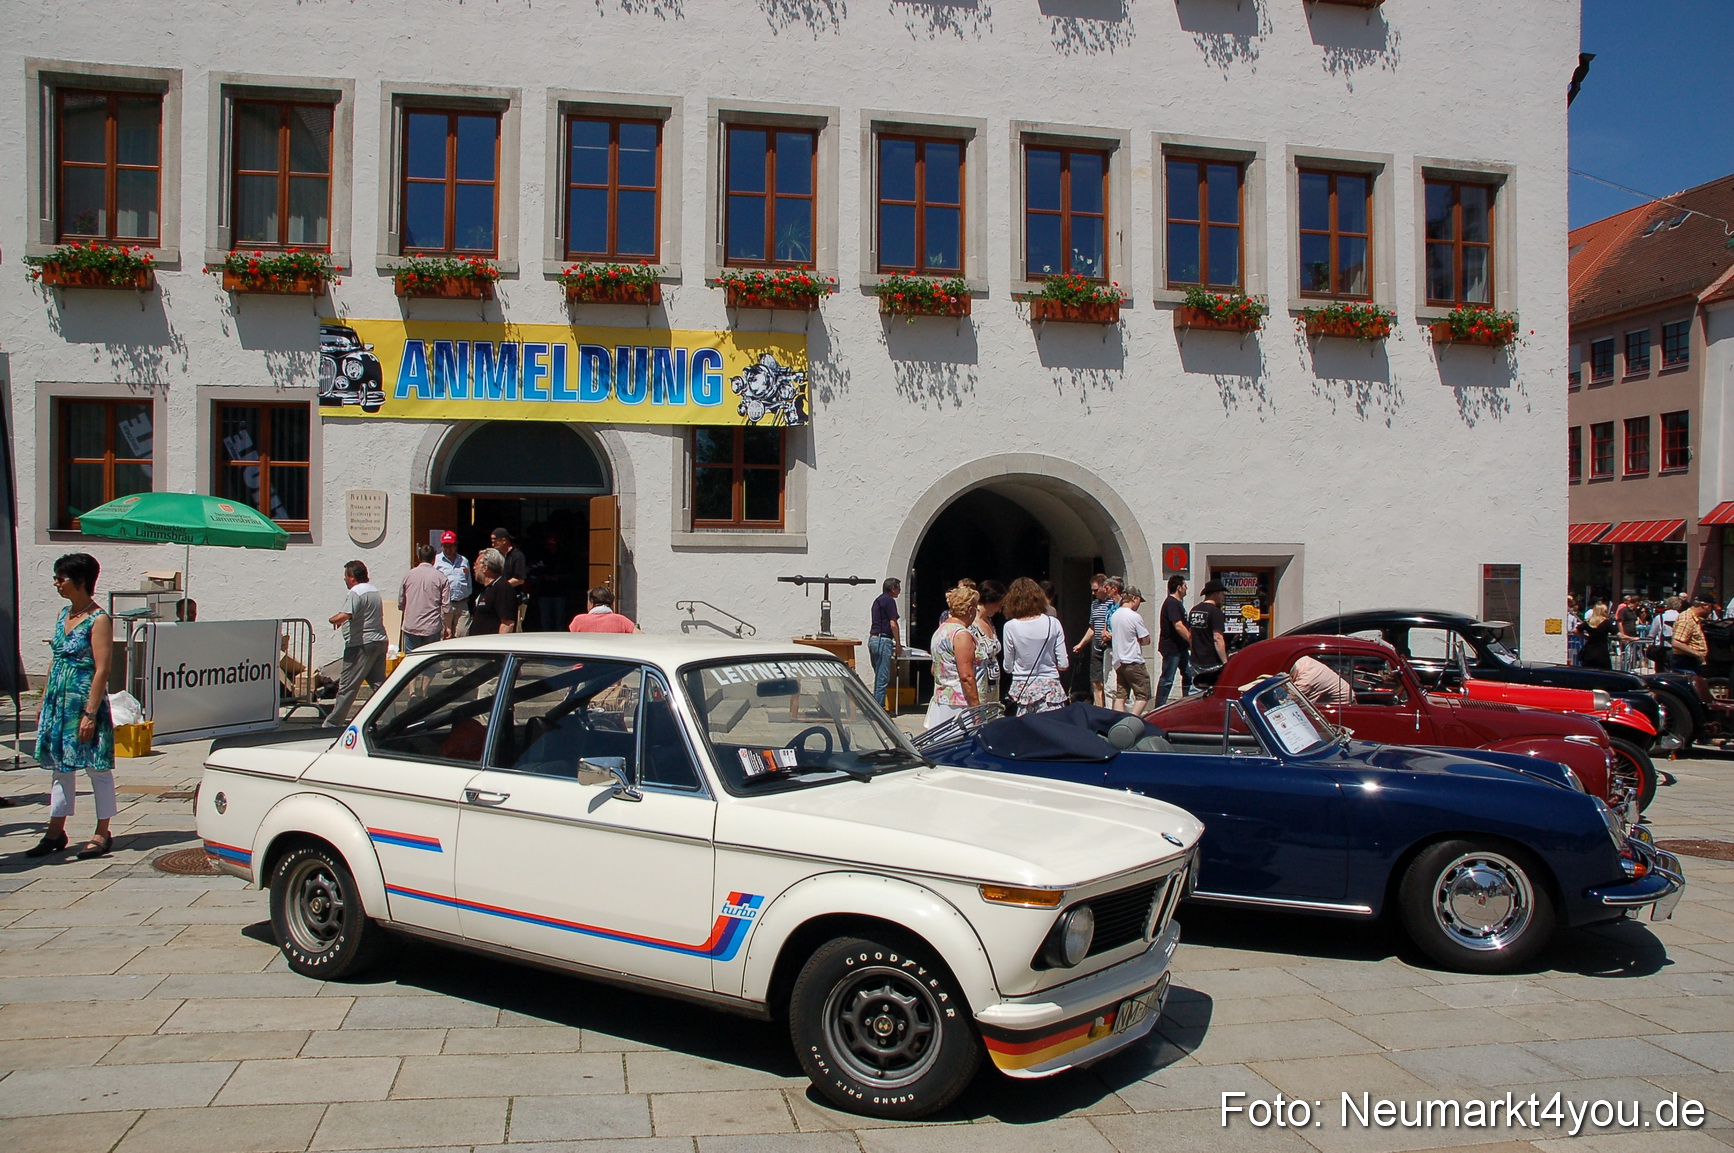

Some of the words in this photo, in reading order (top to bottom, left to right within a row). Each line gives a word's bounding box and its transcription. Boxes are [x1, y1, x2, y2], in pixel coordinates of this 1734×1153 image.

[394, 339, 724, 407] ANMELDUNG
[135, 527, 194, 542] Lammsbräu
[143, 522, 187, 532] Neumarkter
[1226, 586, 1257, 595] EUMARKT
[156, 659, 271, 691] Information
[710, 661, 849, 686] LEITNER-TUNING
[721, 902, 757, 918] turbo
[285, 935, 345, 966] GOODYEAR
[845, 952, 956, 1018] GOODYEAR
[811, 1045, 830, 1075] VR70
[836, 1080, 863, 1099] PRIX
[873, 1093, 915, 1104] GRAND
